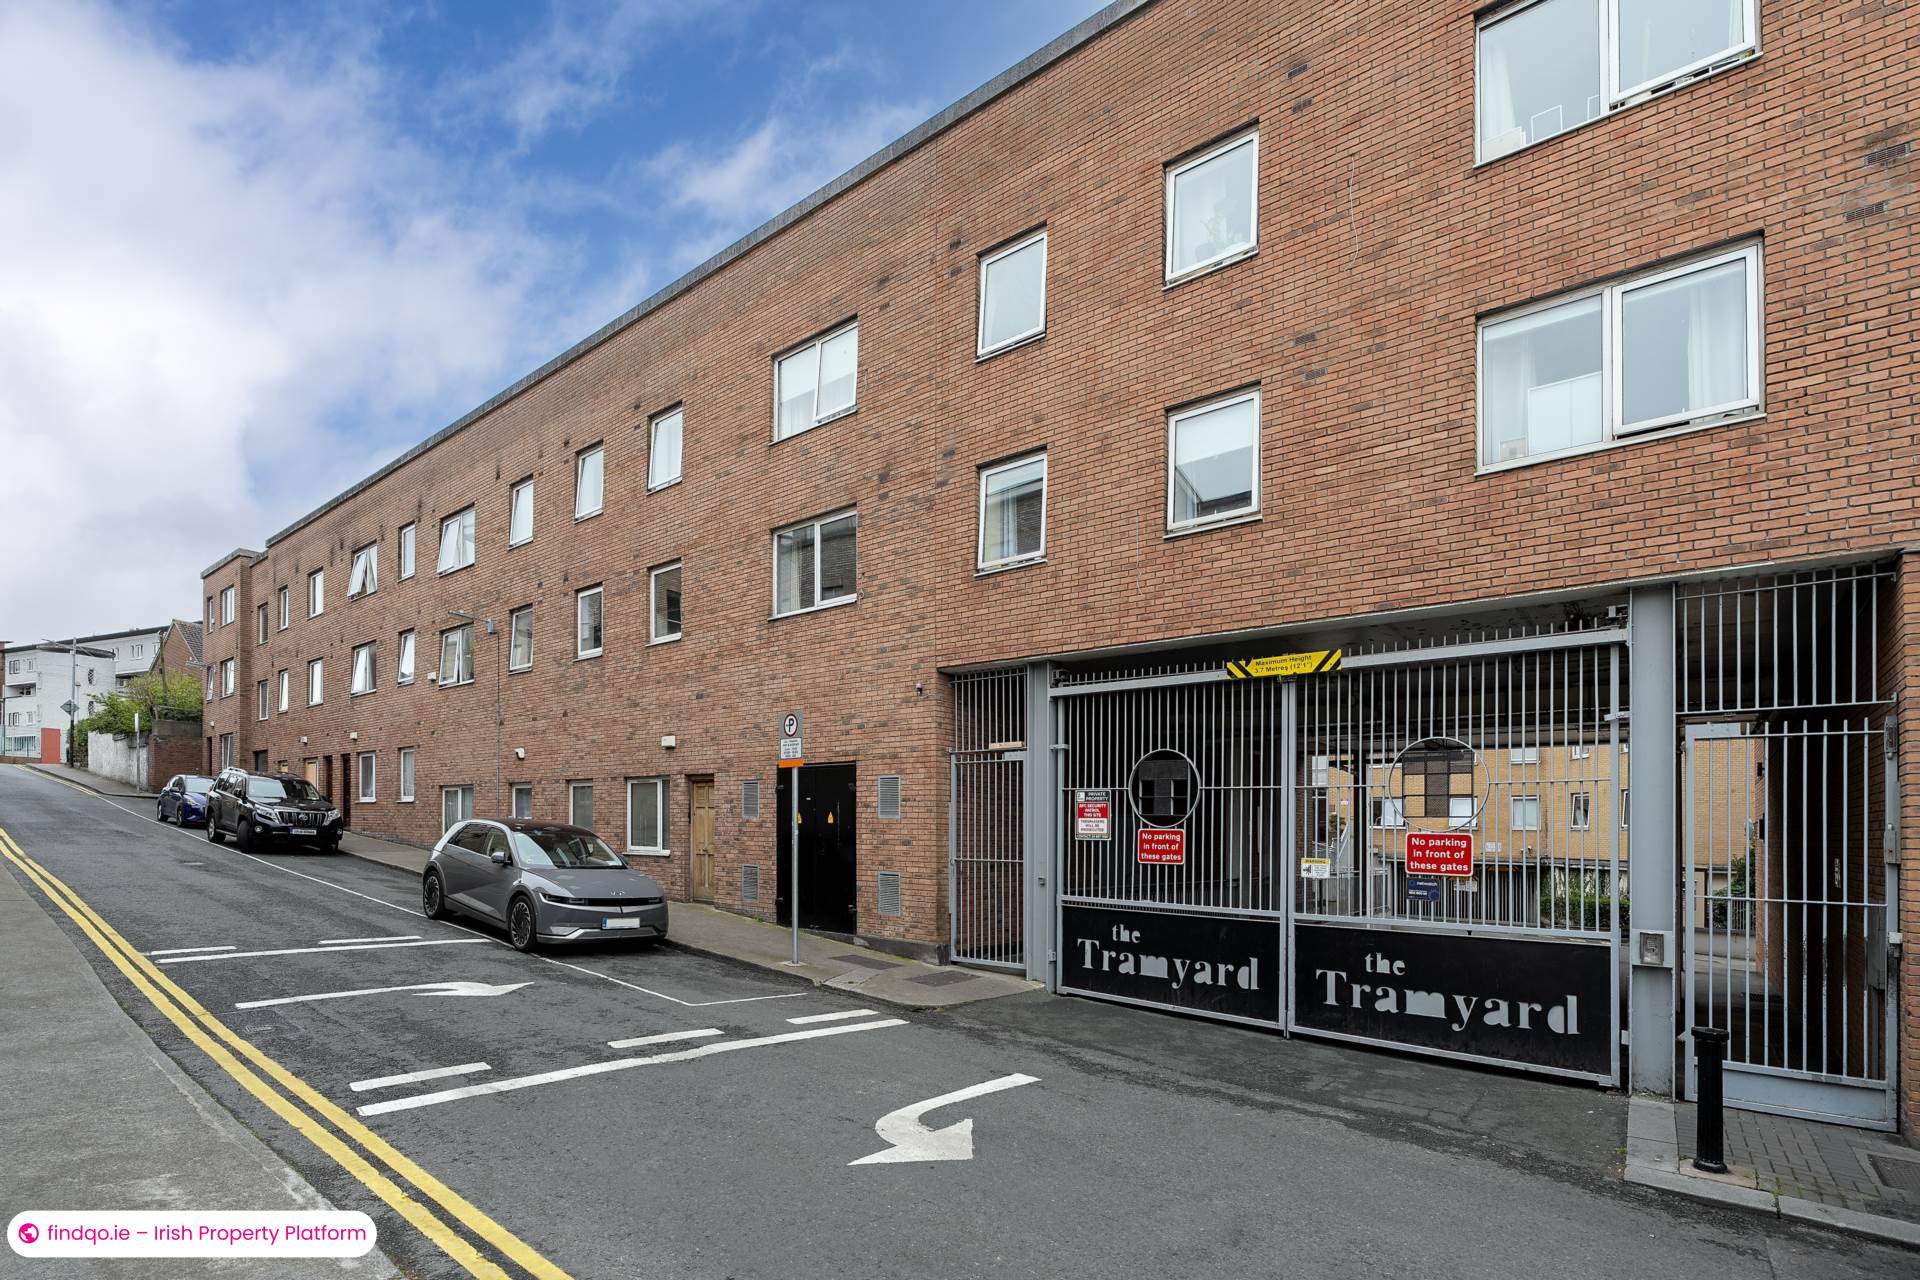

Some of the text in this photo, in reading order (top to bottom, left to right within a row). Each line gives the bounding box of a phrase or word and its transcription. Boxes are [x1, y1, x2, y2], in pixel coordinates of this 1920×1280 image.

[1256, 655, 1312, 667] Maximum Height
[1266, 665, 1288, 673] Metres
[1154, 833, 1181, 842] parking
[1143, 842, 1150, 850] in
[1411, 838, 1467, 848] No parking
[1413, 849, 1465, 859] in front of
[1410, 861, 1468, 871] these gates
[1111, 923, 1141, 944] the
[1077, 938, 1260, 990] Tramyard
[1364, 952, 1406, 976] the
[1315, 968, 1581, 1035] Tramyard
